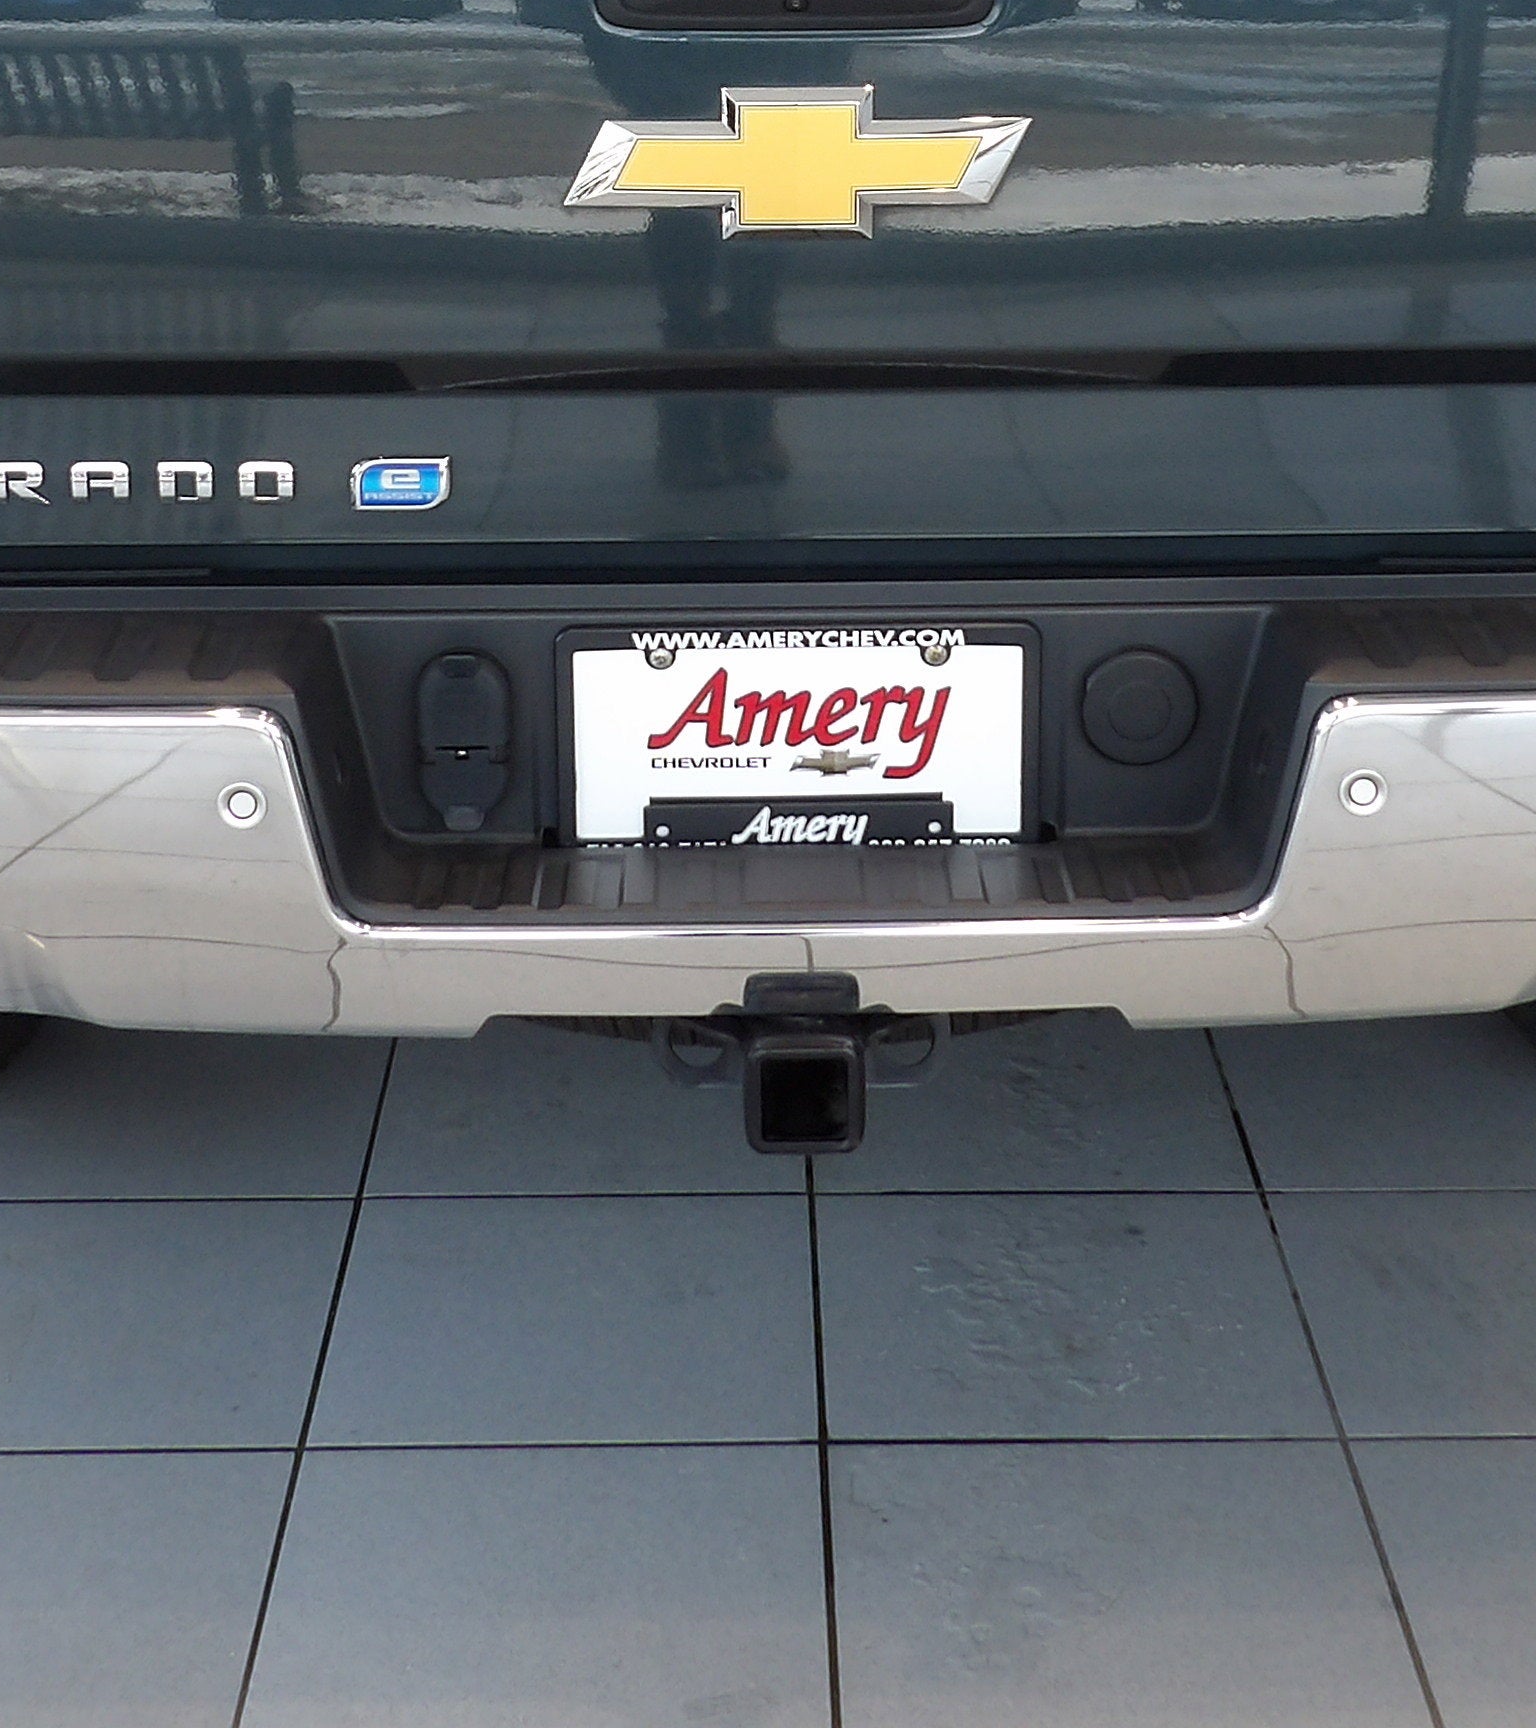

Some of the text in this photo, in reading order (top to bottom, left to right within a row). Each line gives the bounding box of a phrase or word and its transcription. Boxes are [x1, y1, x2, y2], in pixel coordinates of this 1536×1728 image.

[631, 628, 966, 651] WWW.AMERYCHEV.COM
[646, 666, 952, 780] Amery
[650, 756, 772, 770] CHEVROLET
[731, 805, 870, 847] Amery
